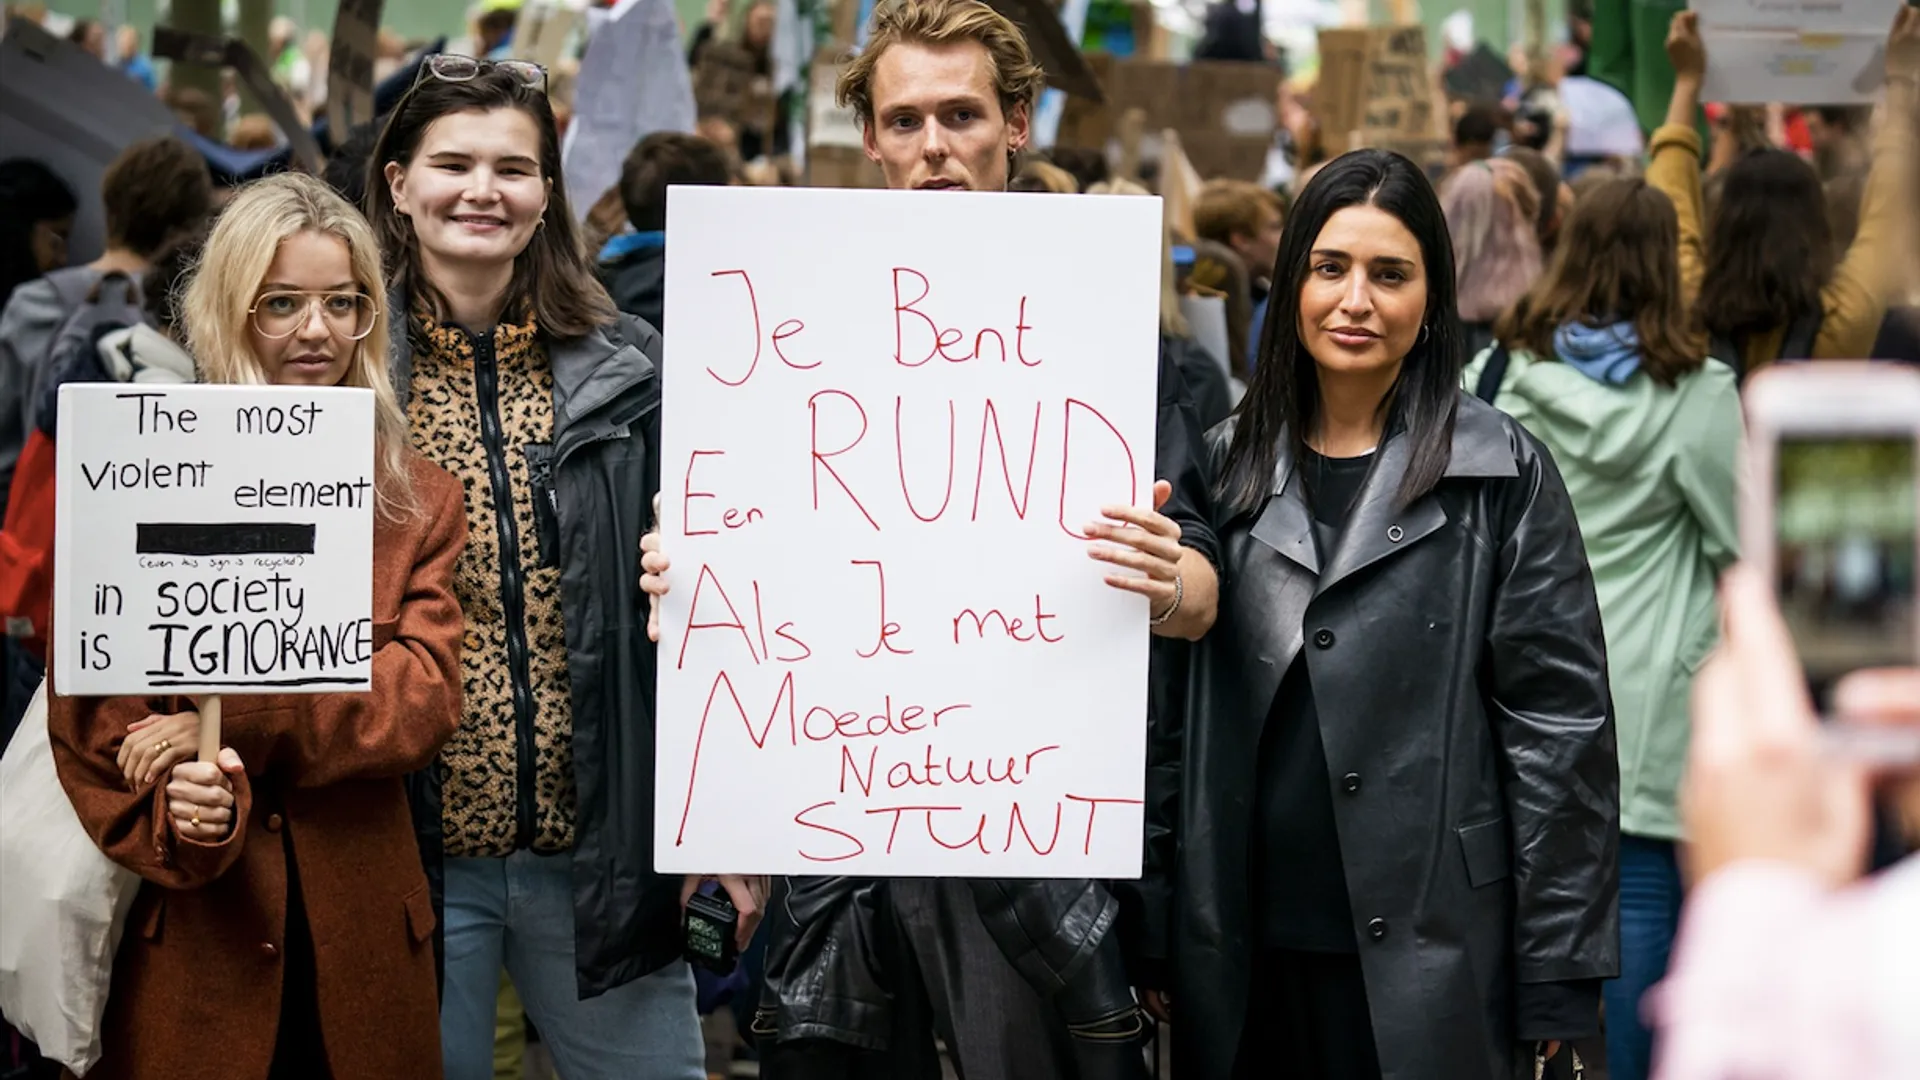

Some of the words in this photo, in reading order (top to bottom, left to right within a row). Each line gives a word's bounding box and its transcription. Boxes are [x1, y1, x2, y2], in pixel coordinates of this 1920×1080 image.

[706, 269, 823, 386] Je
[893, 267, 1043, 367] Bent
[116, 393, 198, 435] The
[236, 401, 323, 436] most
[234, 476, 371, 508] element
[684, 450, 764, 536] Een
[808, 389, 1136, 541] RUND
[94, 583, 123, 616] in
[678, 563, 812, 670] Als
[851, 559, 914, 658] Je
[953, 594, 1065, 644] met
[80, 631, 112, 671] is
[676, 670, 972, 847] Moeder
[839, 744, 1061, 797] Natuur
[794, 794, 1143, 861] STUNT
